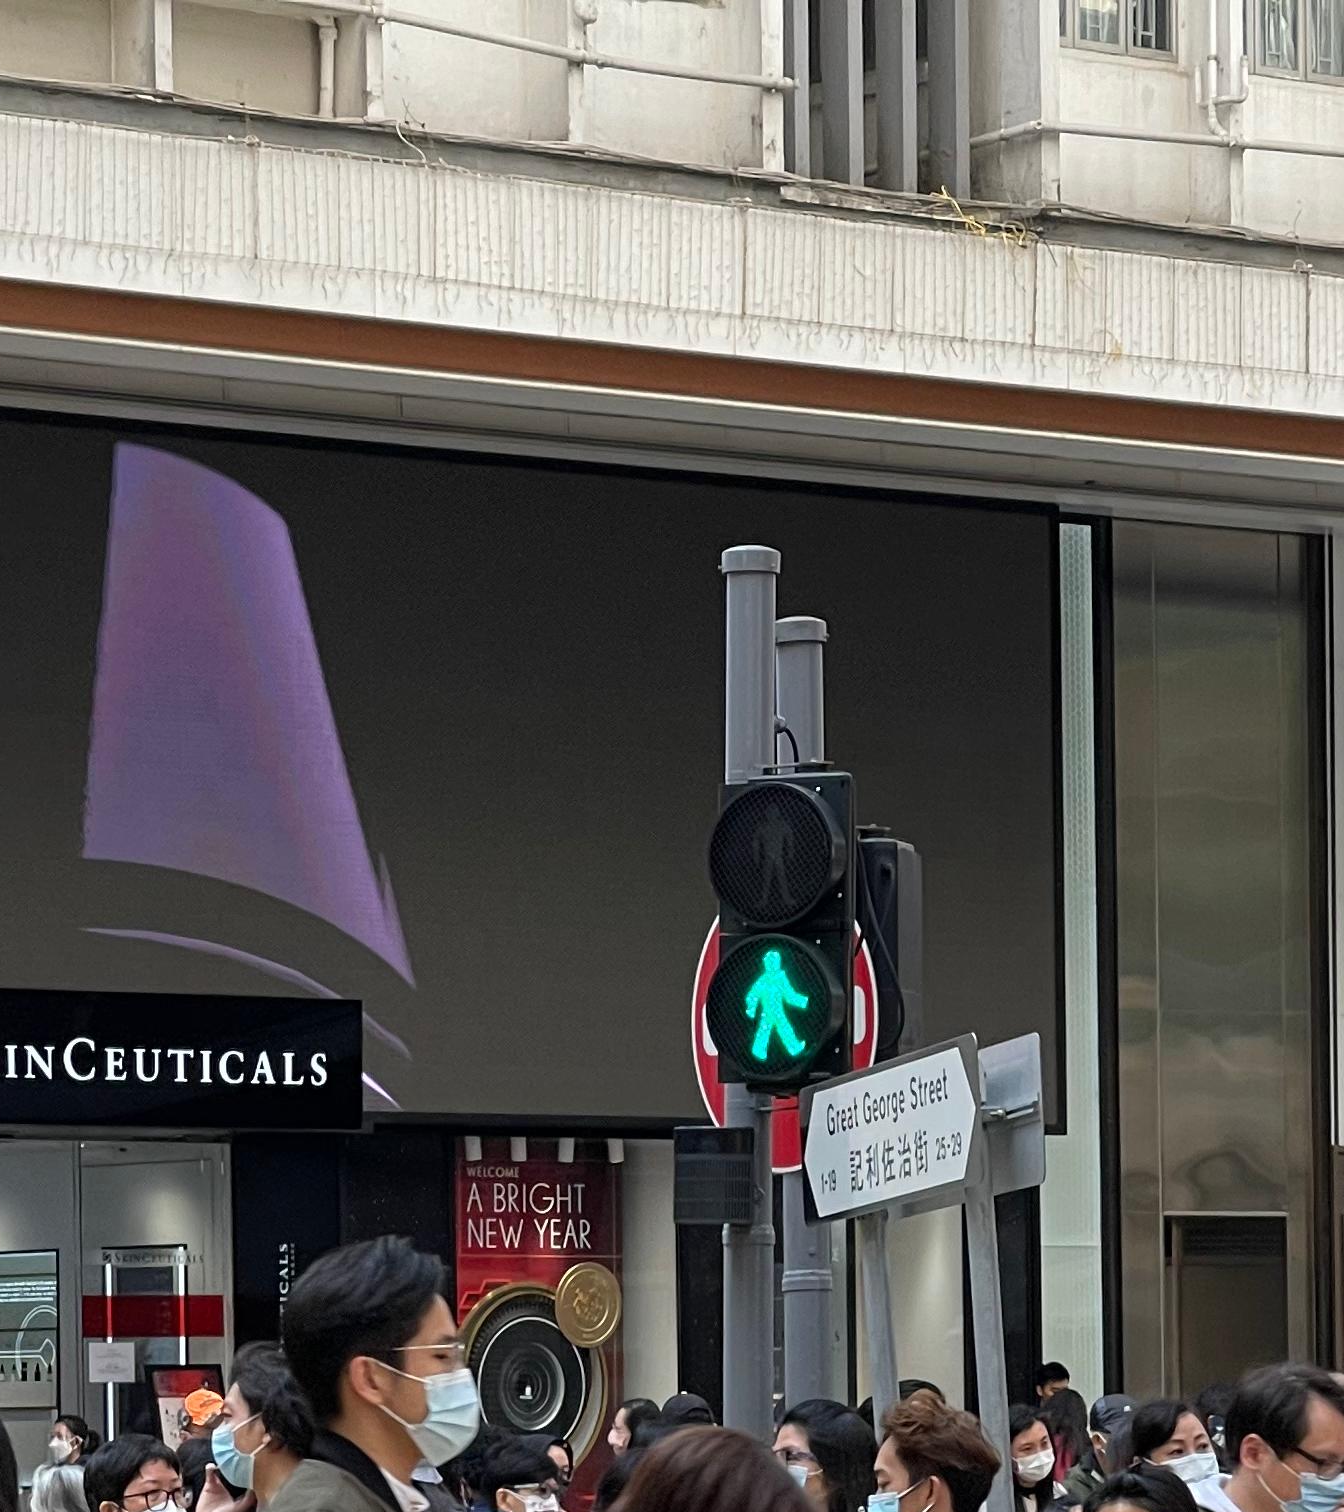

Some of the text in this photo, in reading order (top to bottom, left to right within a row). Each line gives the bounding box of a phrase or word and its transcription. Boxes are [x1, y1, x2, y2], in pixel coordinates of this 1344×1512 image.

[826, 1068, 948, 1136] Great George Street
[466, 1166, 519, 1178] WELCOME
[820, 1130, 962, 1194] 1-19 記利佐治街 25-29
[466, 1182, 585, 1214] A BRIGHT
[467, 1218, 592, 1250] NEW YEAR
